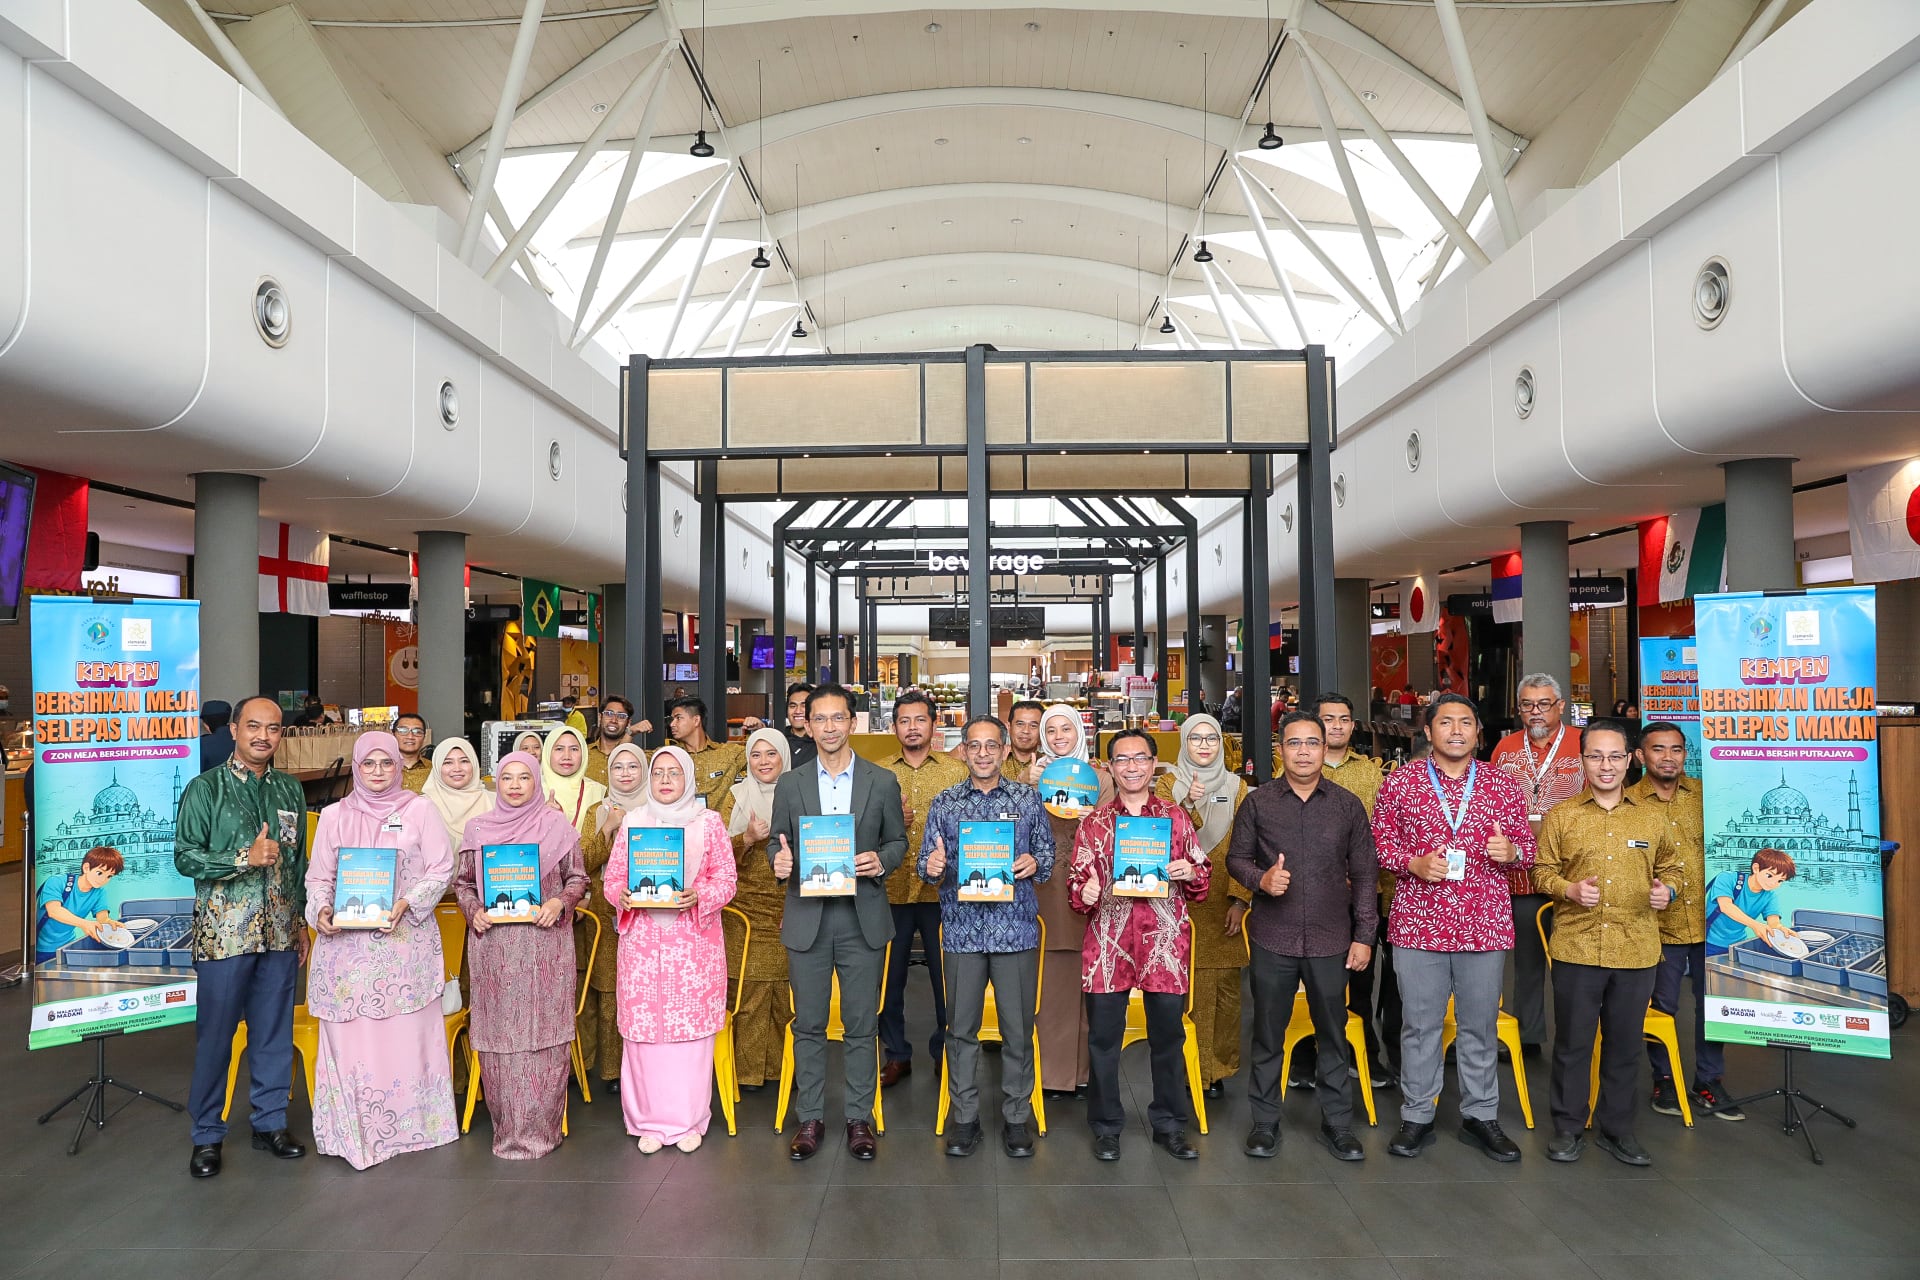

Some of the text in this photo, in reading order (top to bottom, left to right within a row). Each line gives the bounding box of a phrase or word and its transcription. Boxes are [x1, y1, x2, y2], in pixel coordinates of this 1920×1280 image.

[928, 550, 1044, 575] bevrage
[87, 576, 120, 596] roti
[1580, 584, 1610, 594] penyet
[340, 591, 388, 601] wafflestop
[468, 608, 476, 618] 3
[76, 661, 160, 687] KEMPEN
[1740, 655, 1830, 684] KEMPEN
[1642, 685, 1693, 697] BERSIHKAN
[35, 690, 198, 715] BERSIHKAN MEJA
[1643, 699, 1683, 711] SELEPAS
[1702, 688, 1808, 712] BERSIHKAN
[1814, 687, 1875, 710] MEJA
[35, 716, 199, 744] SELEPAS MAKAN
[1702, 714, 1876, 742] SELEPAS MAKAN
[50, 748, 178, 760] ZON MEJA BERSIH PUTRAJAYA
[1718, 750, 1854, 758] ZON MEJA BERSIH PUTRAJAYA
[118, 998, 139, 1011] 30
[1792, 1012, 1815, 1025] 30
